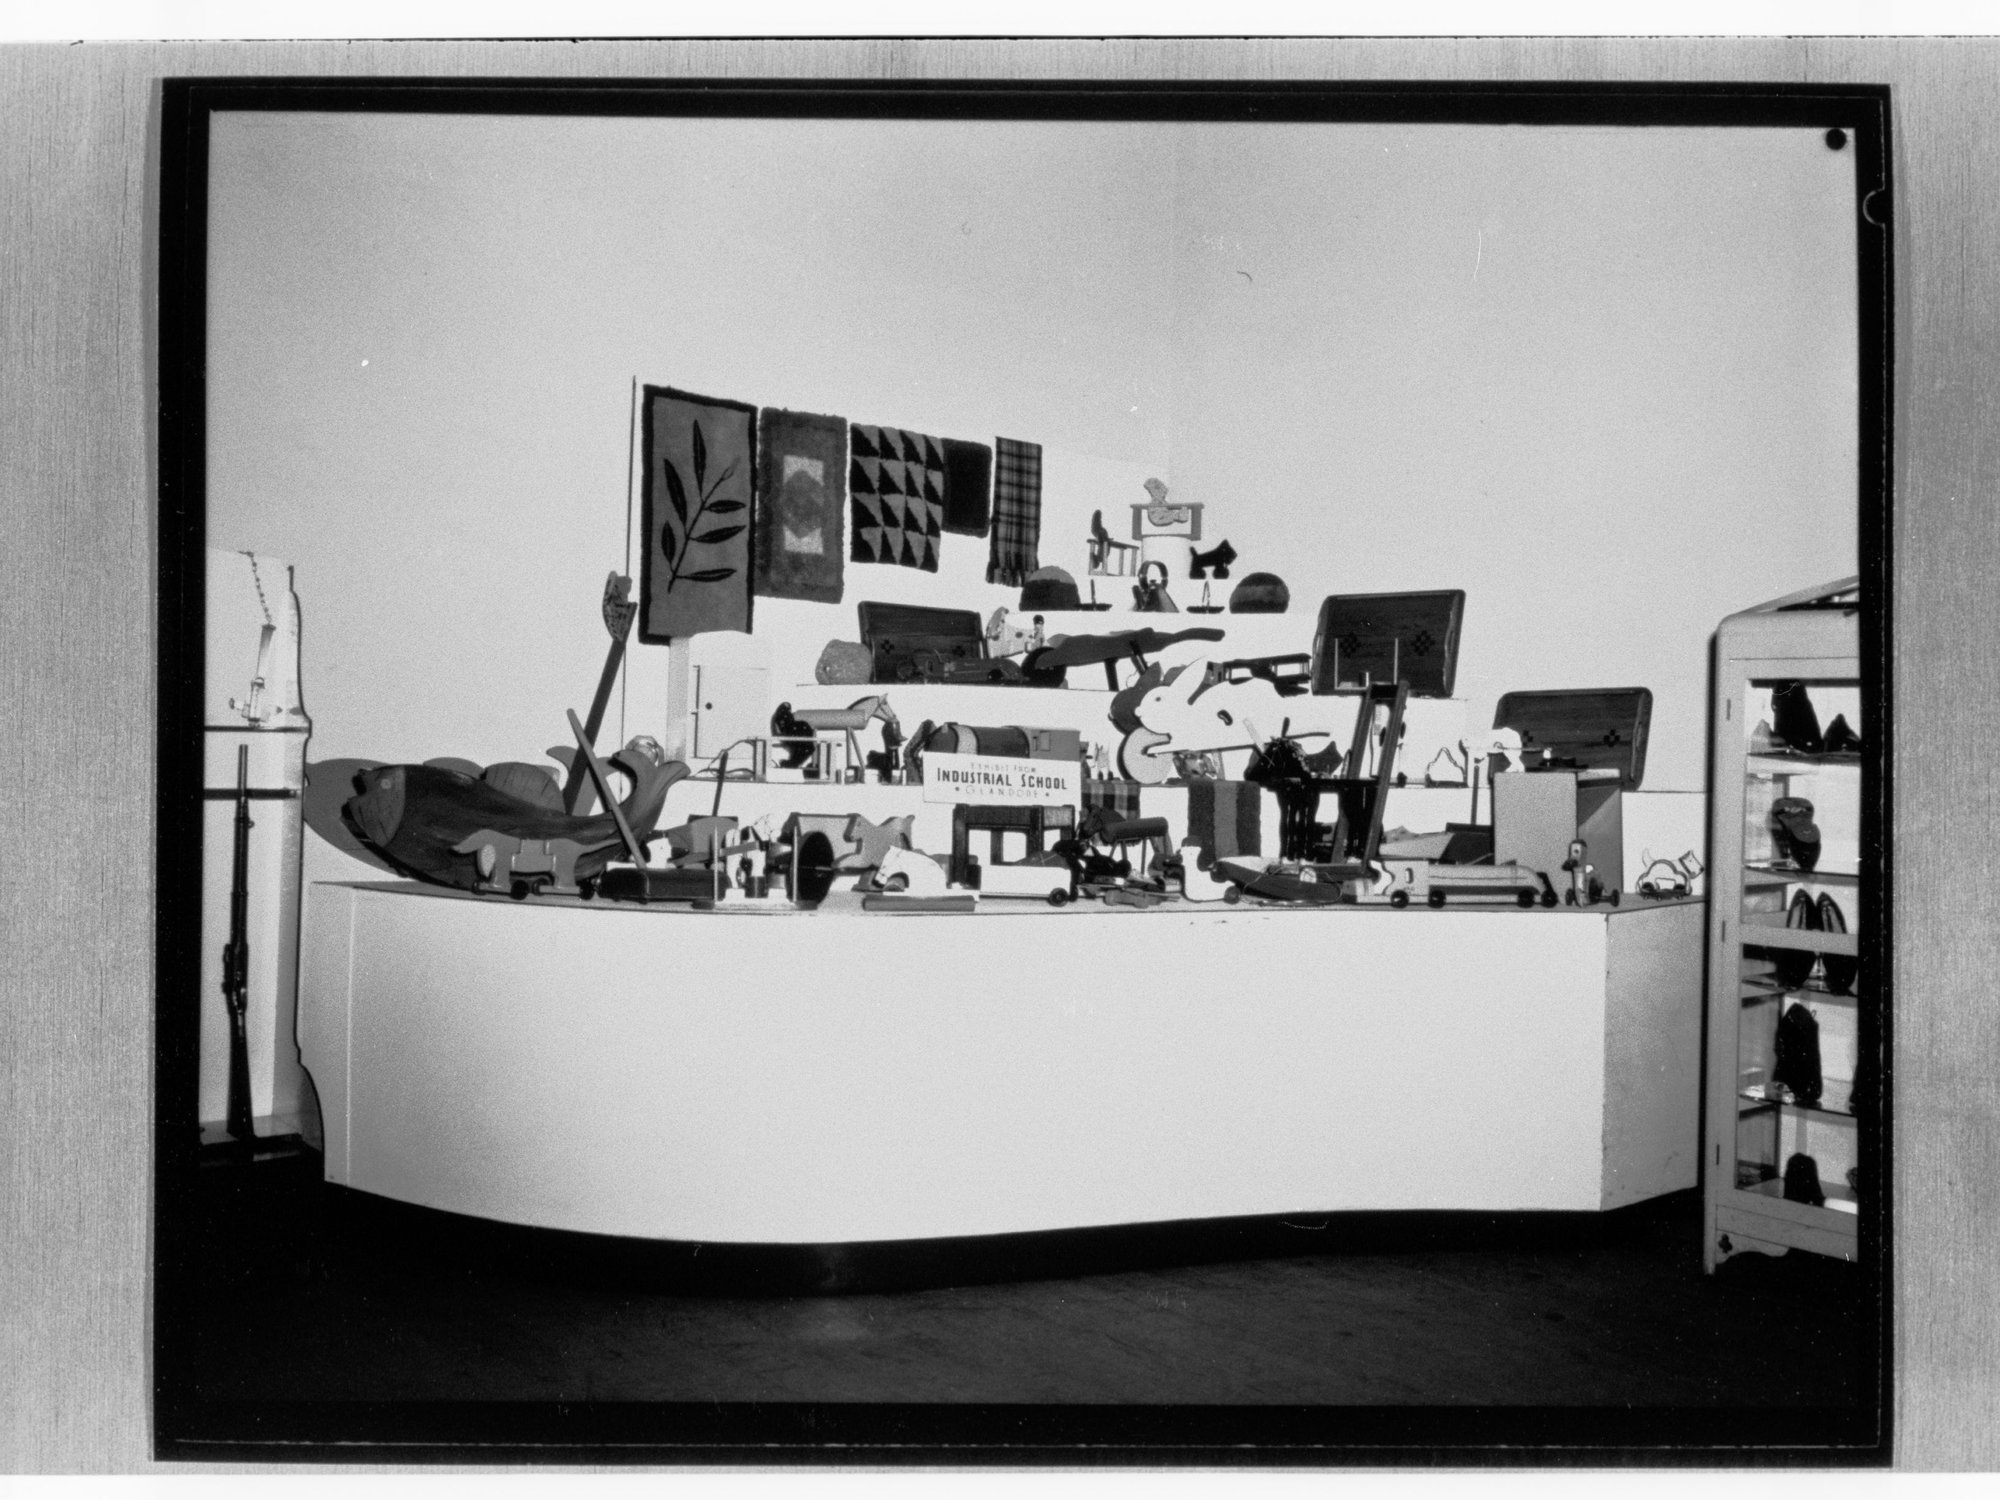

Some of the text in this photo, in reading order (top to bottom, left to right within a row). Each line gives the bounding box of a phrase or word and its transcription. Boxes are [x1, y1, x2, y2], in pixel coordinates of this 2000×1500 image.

[1014, 764, 1036, 773] FROM
[937, 767, 1067, 790] INDUSTRIAL SCHOOL
